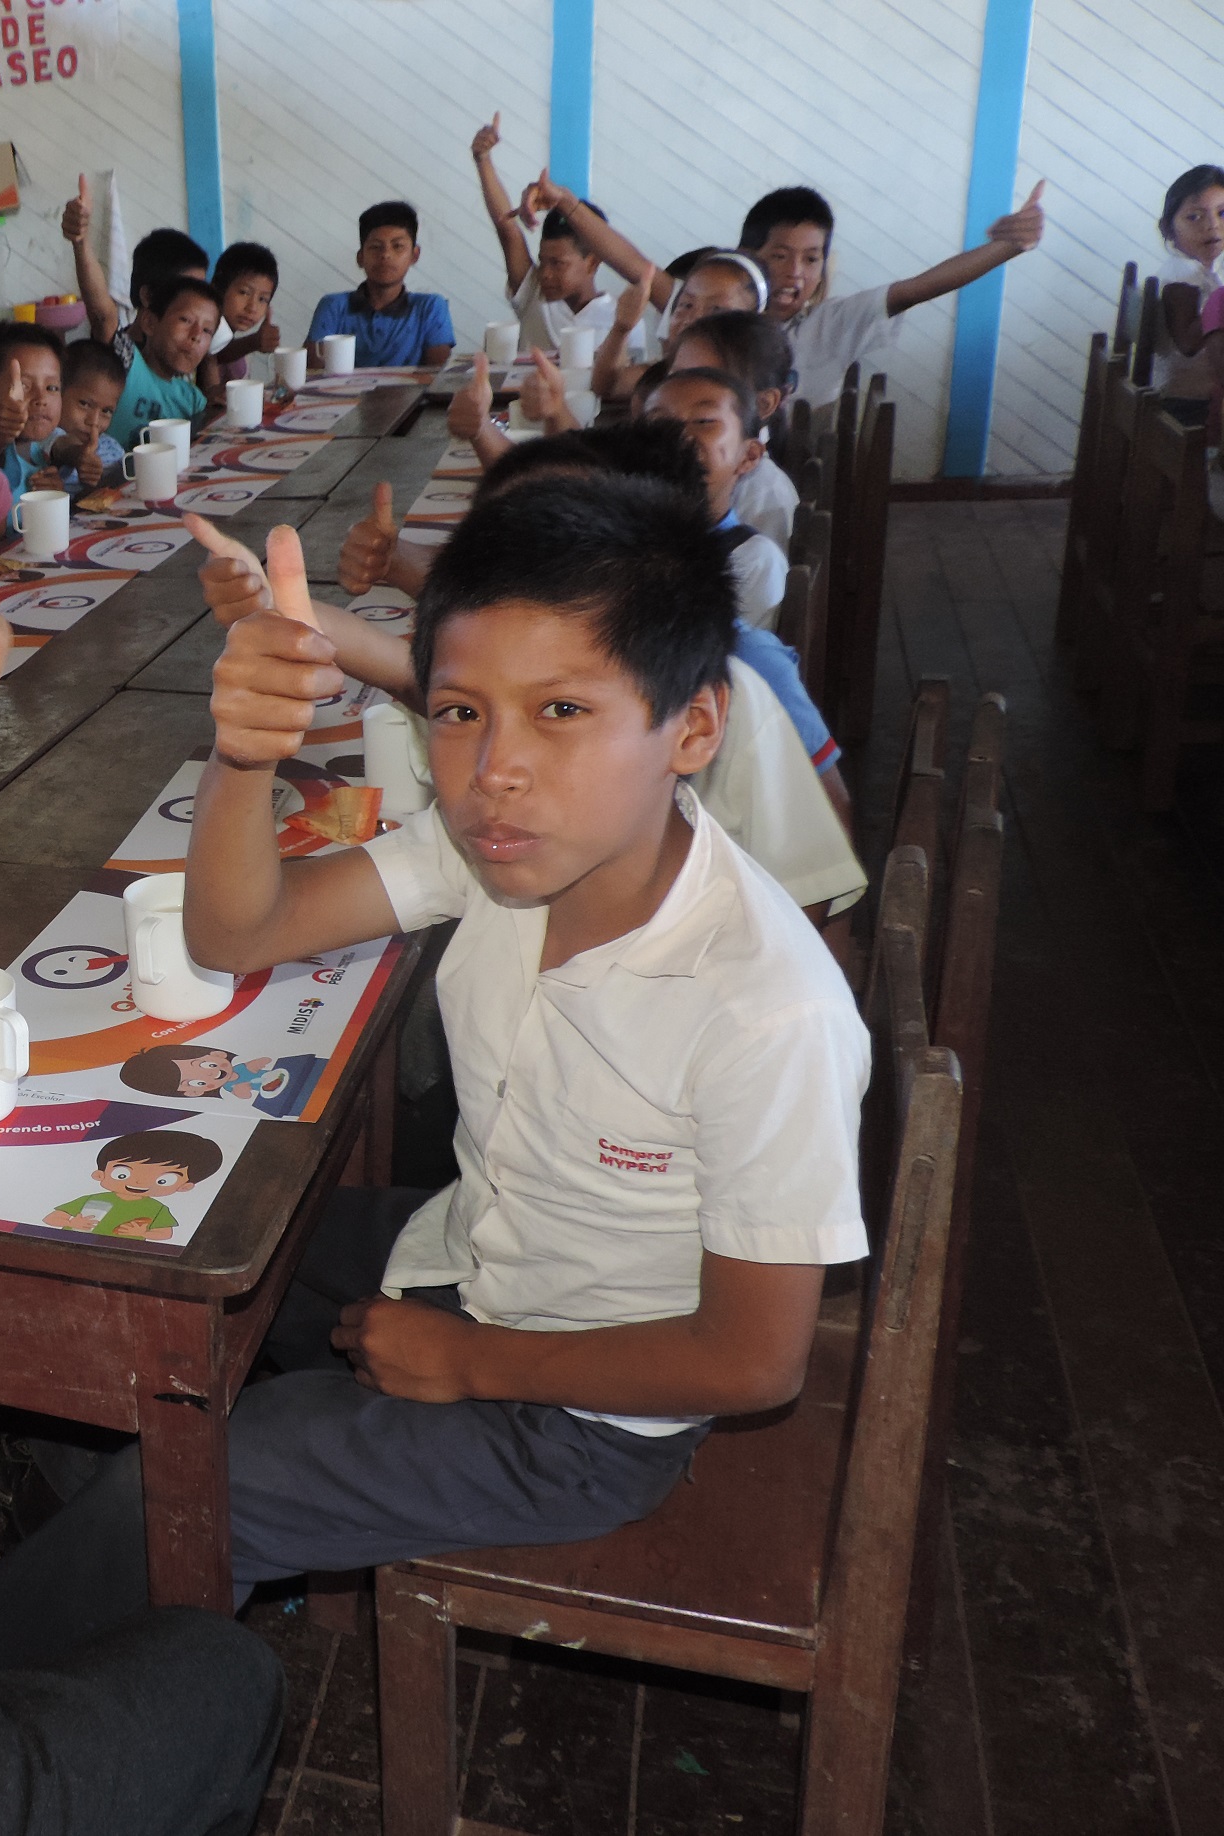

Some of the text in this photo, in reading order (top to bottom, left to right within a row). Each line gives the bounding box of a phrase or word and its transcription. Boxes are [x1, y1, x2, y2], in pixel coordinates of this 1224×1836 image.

[1, 13, 46, 48] DE
[287, 1008, 314, 1035] MIDIS
[151, 1026, 176, 1039] Con
[30, 1093, 63, 1102] Escolar
[55, 1120, 102, 1132] mejor
[599, 1138, 674, 1160] Compras
